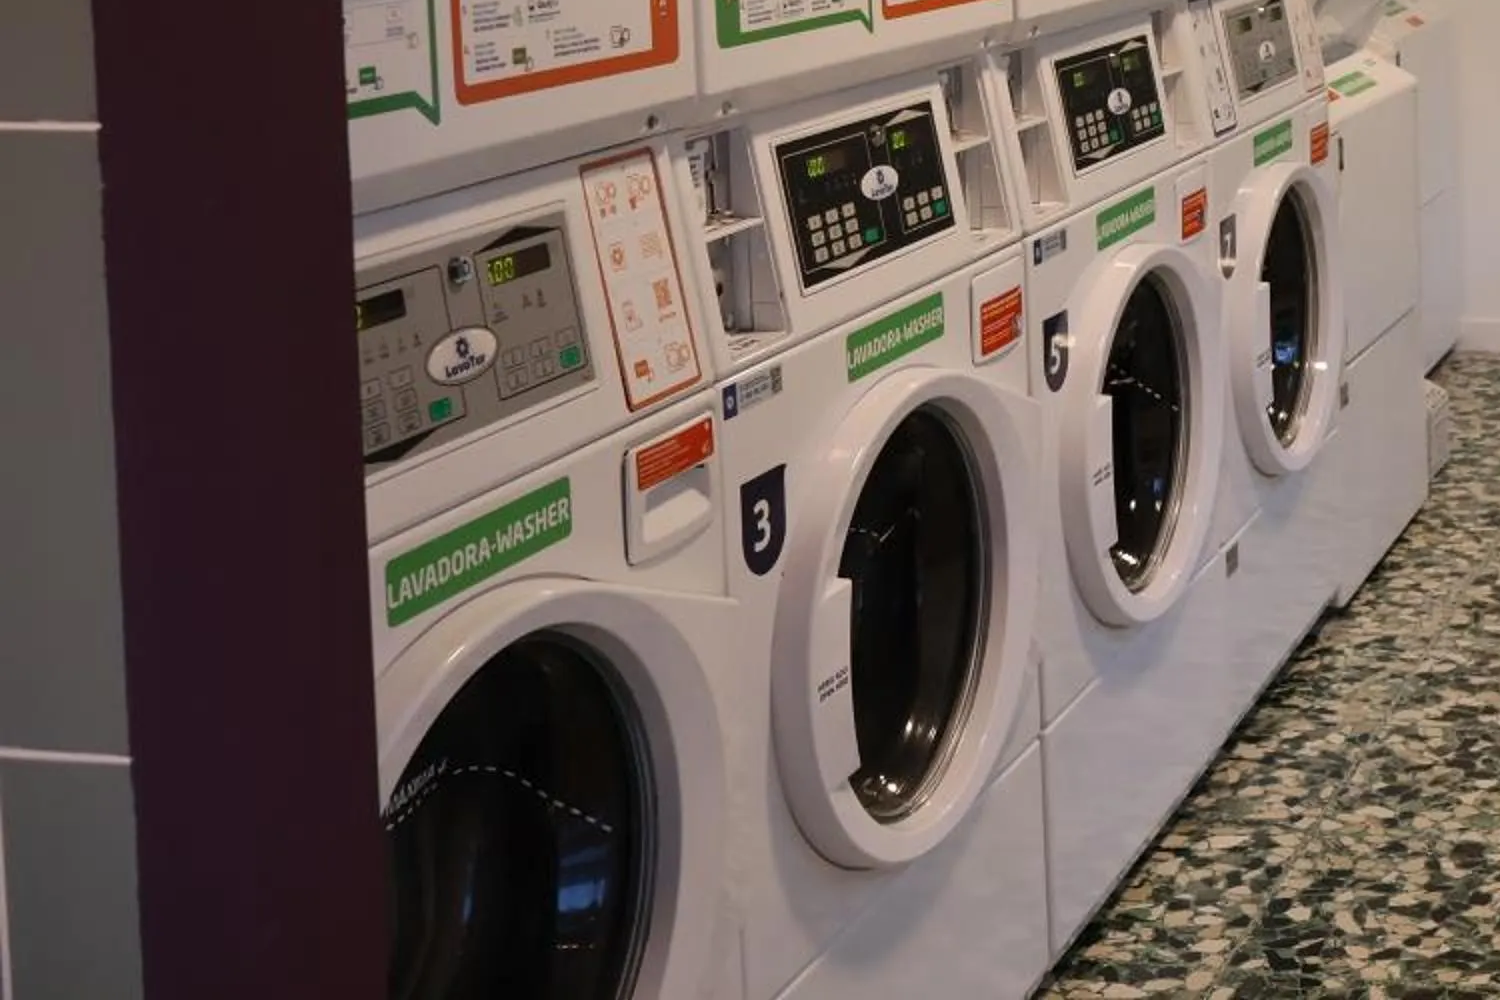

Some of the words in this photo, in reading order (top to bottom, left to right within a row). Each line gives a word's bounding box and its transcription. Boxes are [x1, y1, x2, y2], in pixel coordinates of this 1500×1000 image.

[1050, 334, 1064, 375] 5
[386, 497, 571, 609] LAVADORA-WASHER
[752, 498, 772, 553] 3
